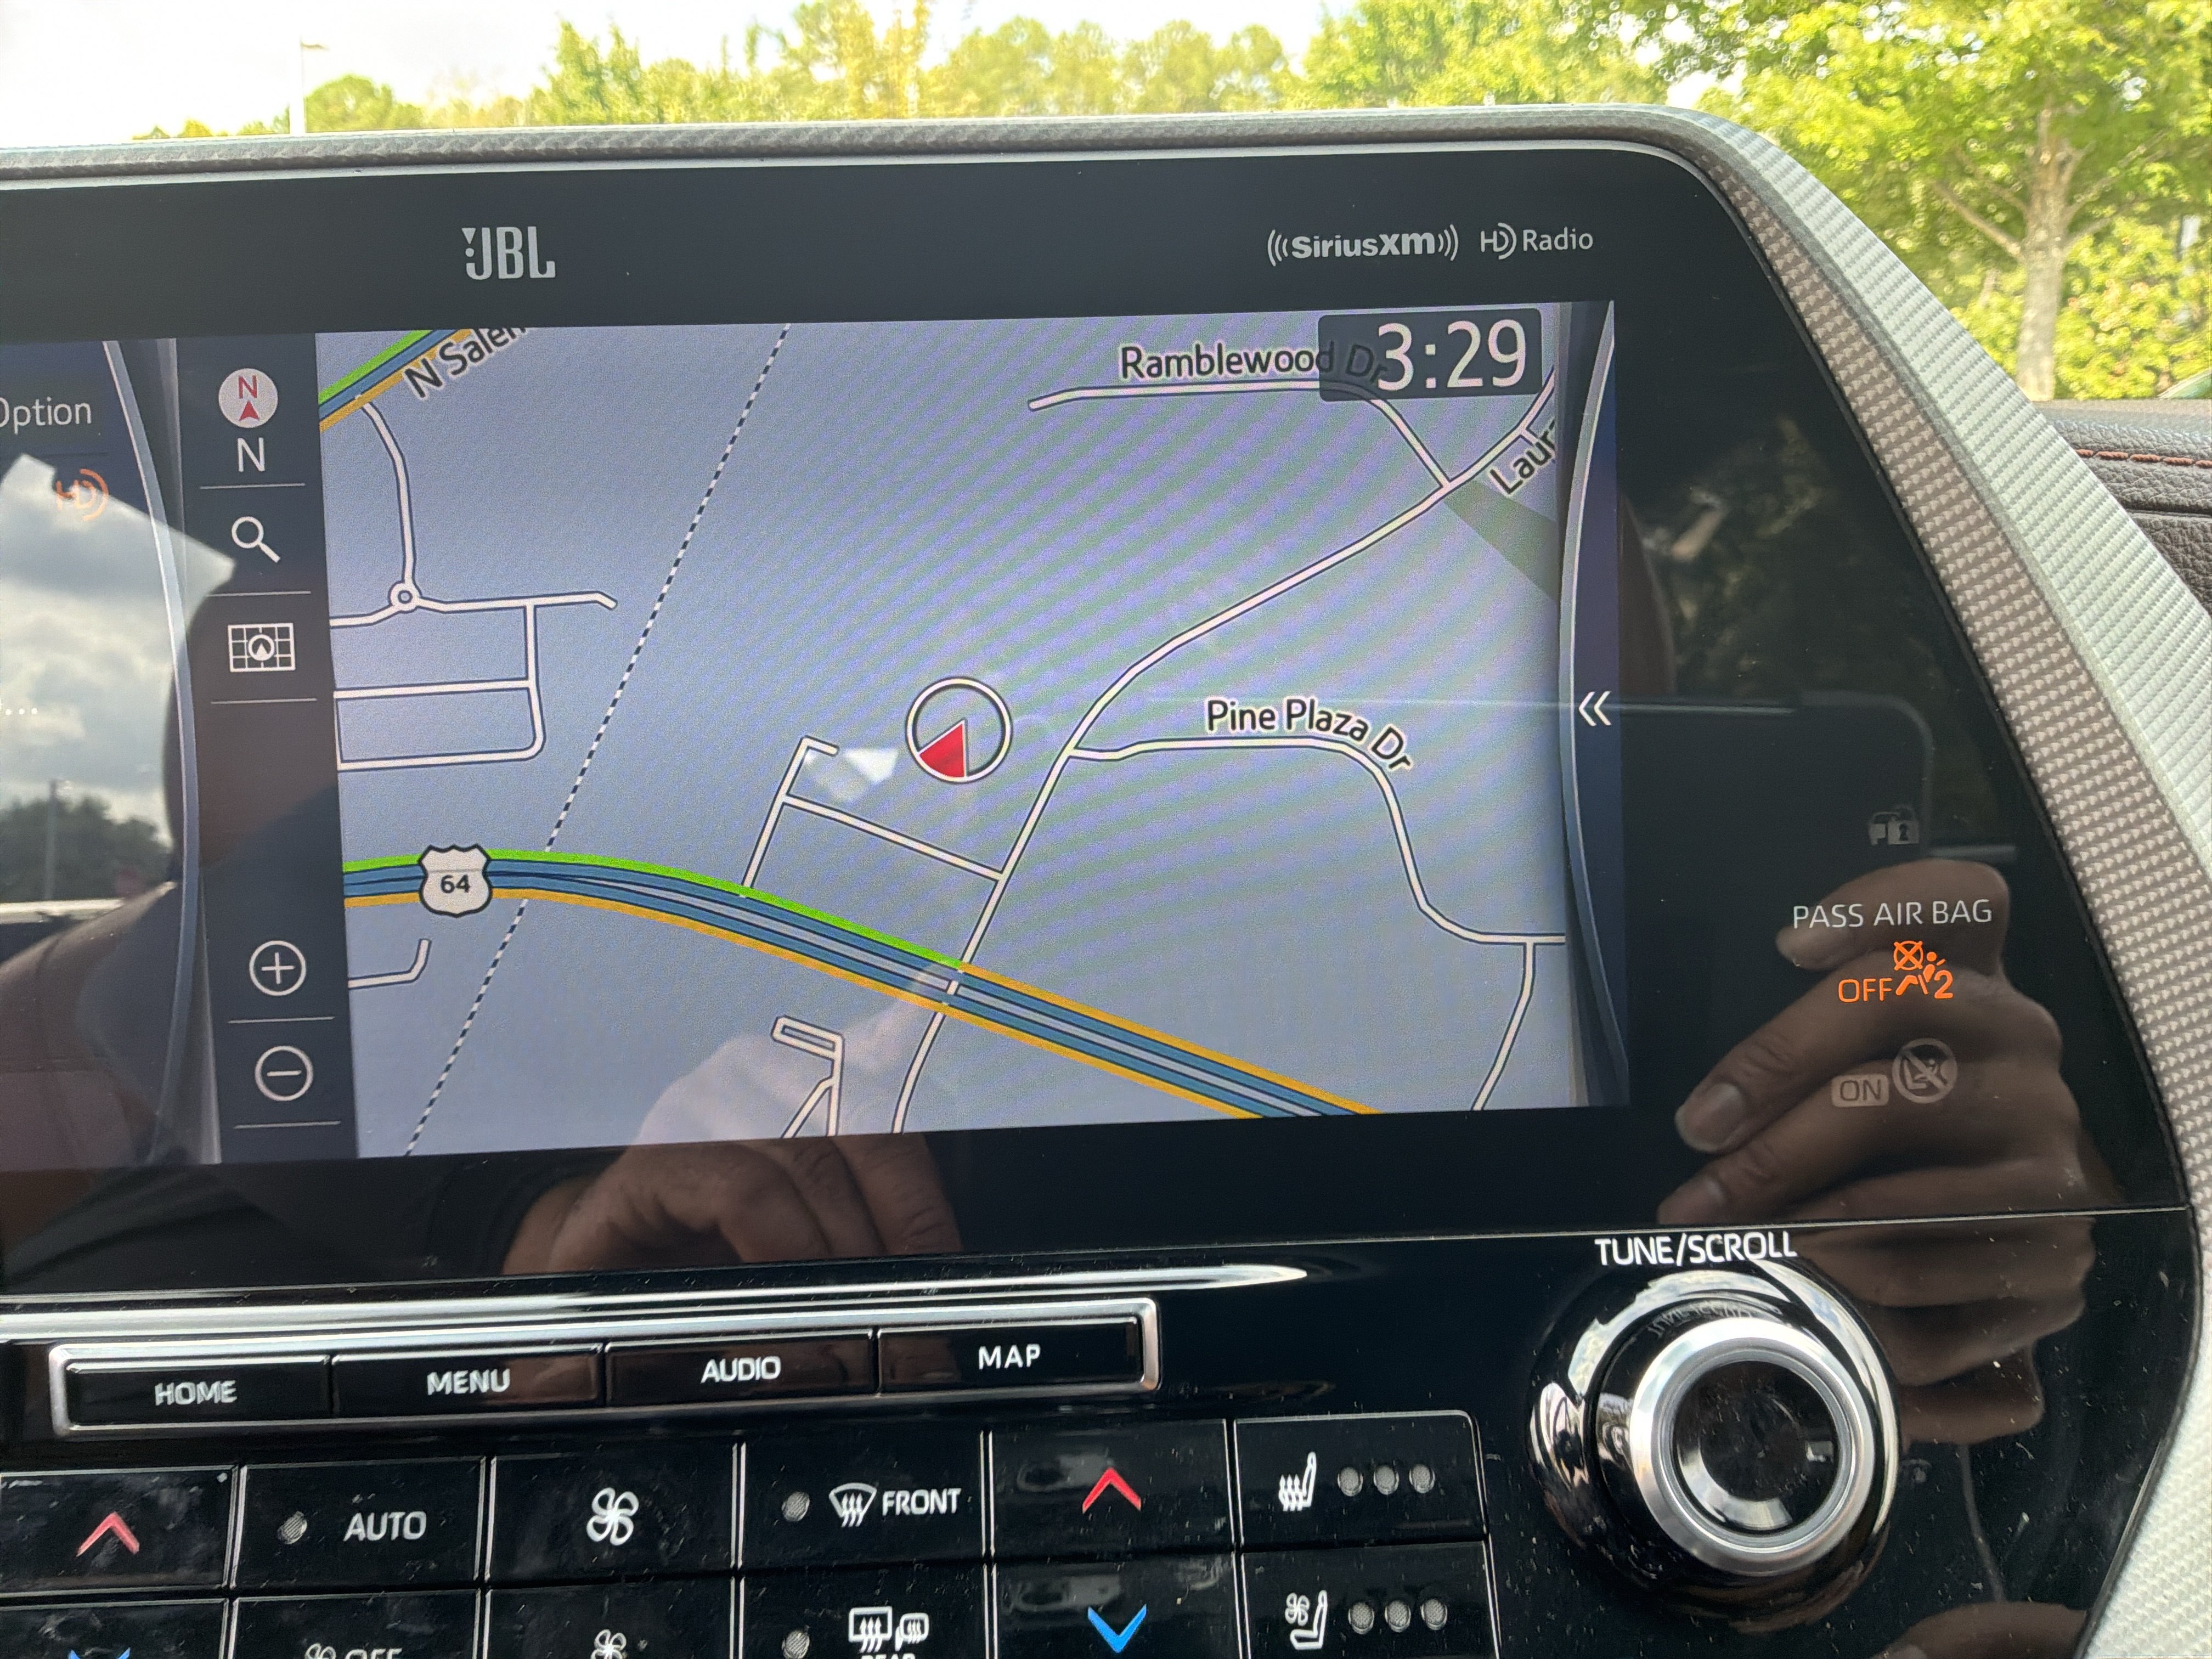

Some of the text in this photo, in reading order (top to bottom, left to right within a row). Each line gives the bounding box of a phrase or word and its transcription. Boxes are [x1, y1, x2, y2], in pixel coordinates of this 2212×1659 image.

[461, 226, 556, 280] JBL
[1522, 227, 1593, 252] Radio
[1121, 341, 1335, 379] Ramblewood
[1377, 318, 1527, 392] 3:29
[238, 375, 257, 399] N
[404, 358, 443, 398] N
[237, 437, 265, 472] N
[1207, 698, 1411, 769] Pine Plaza Dr
[441, 874, 470, 894] 64
[1793, 899, 1992, 929] PASS AIR BAG
[1838, 969, 1954, 1003] OFF 2
[1839, 1079, 1882, 1103] ON
[1594, 1230, 1798, 1267] TUNE/SCROLL
[700, 1356, 781, 1385] AUDIO
[979, 1344, 1041, 1370] MAP
[154, 1380, 238, 1406] HOME
[427, 1368, 510, 1396] MENU
[882, 1487, 962, 1516] FRONT
[342, 1511, 427, 1542] AUTO
